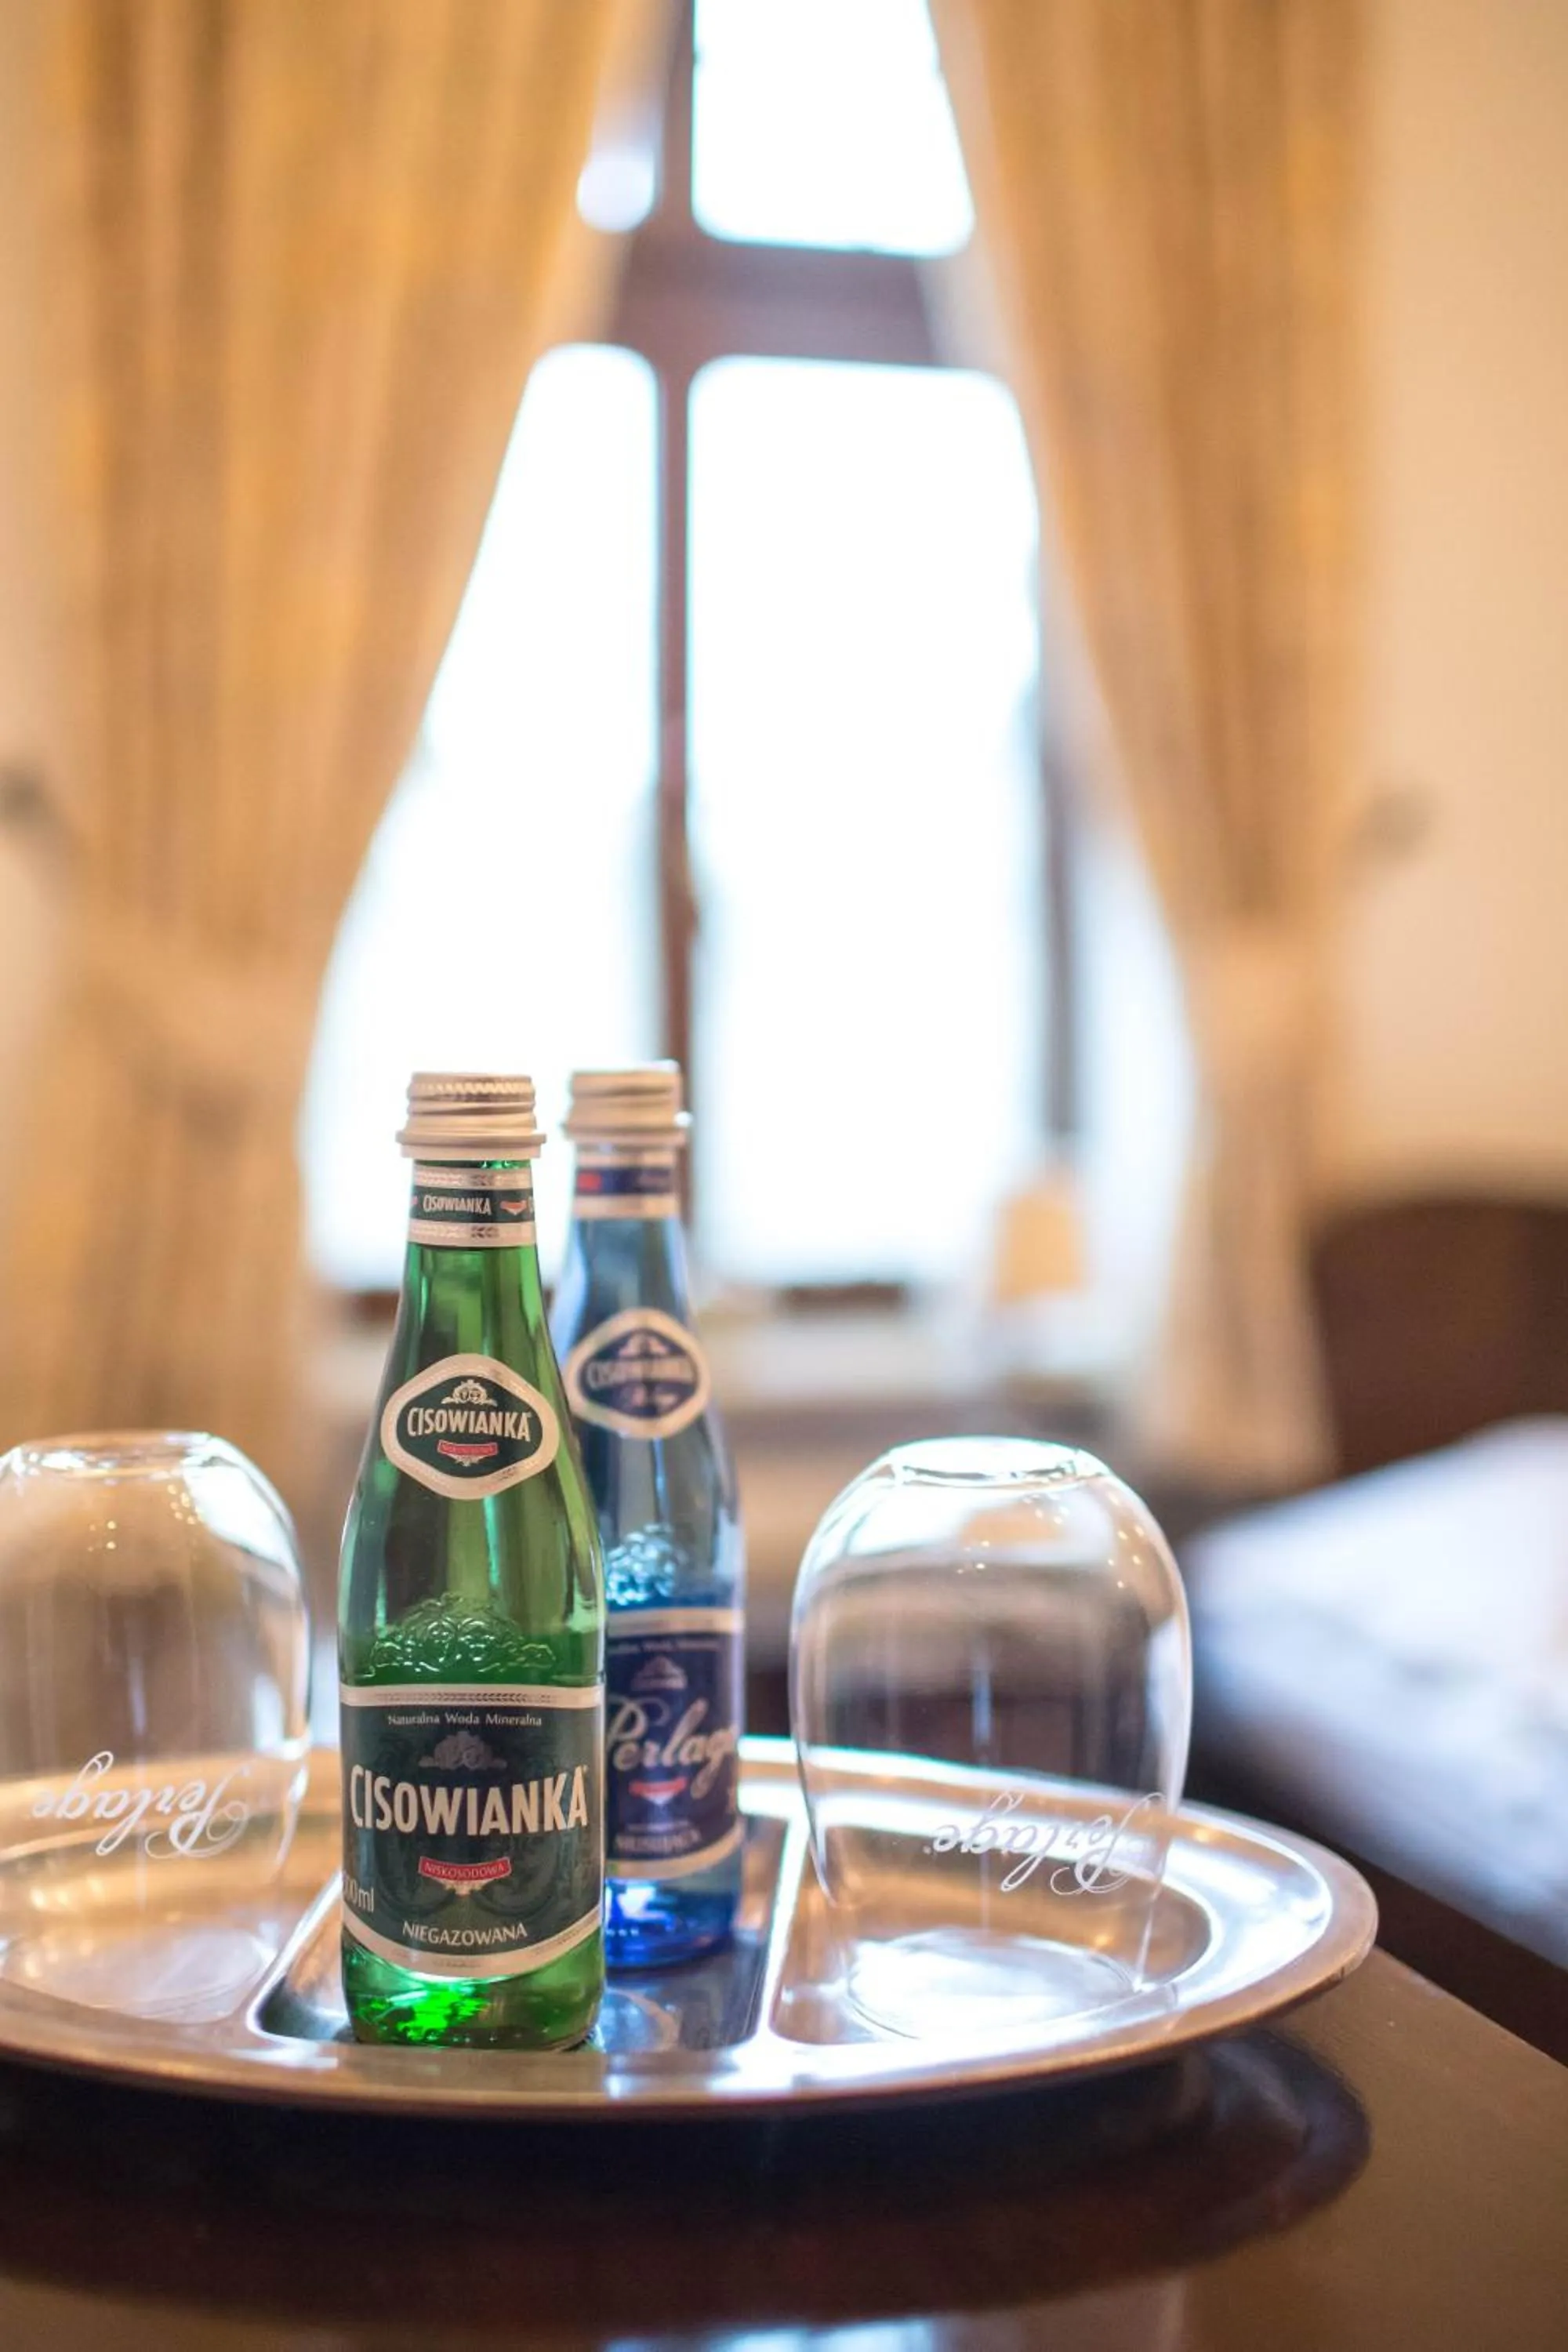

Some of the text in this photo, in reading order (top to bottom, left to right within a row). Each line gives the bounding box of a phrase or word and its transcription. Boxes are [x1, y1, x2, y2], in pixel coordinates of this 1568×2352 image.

[407, 1407, 532, 1442] CISOWIANKA
[445, 1711, 480, 1725] Woda
[485, 1713, 543, 1726] Mineralna
[32, 1750, 250, 1859] Perlage
[350, 1764, 588, 1836] CISOWIANKA
[931, 1791, 1166, 1896] Perlage
[423, 1861, 506, 1879] NISKOSODOWA
[401, 1921, 528, 1947] NIEGAZOWANA
